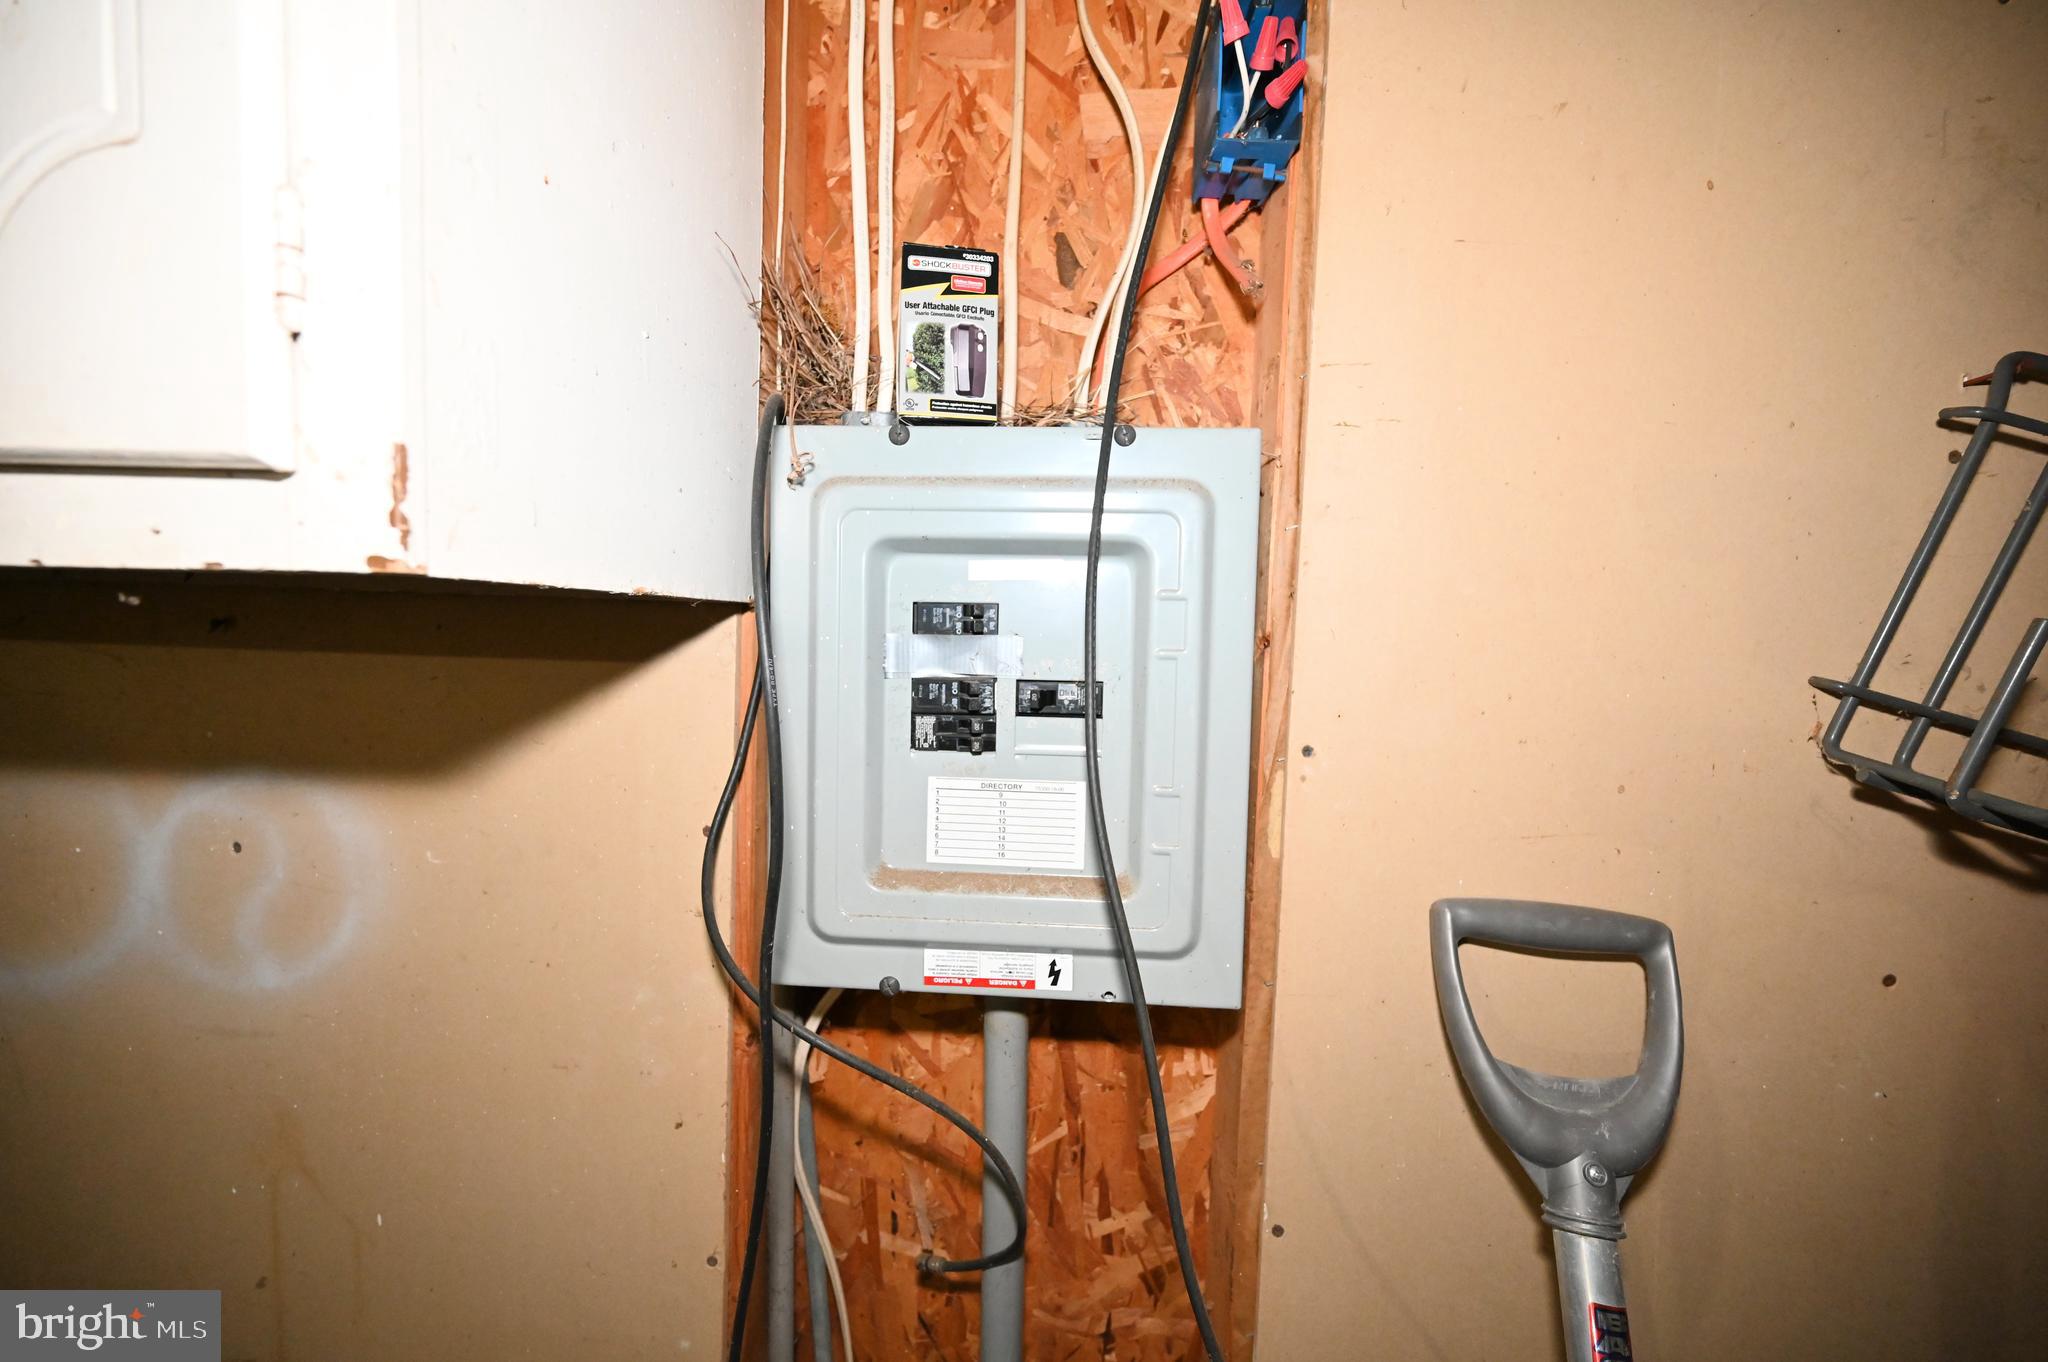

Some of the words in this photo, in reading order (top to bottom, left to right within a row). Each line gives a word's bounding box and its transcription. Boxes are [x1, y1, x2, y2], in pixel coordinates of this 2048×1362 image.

[921, 260, 986, 273] SHOCKBUSTER
[904, 301, 920, 309] User
[922, 301, 960, 312] Attachable
[962, 304, 977, 314] GFCI
[979, 306, 995, 317] Plug
[981, 782, 1022, 790] DIRECTORY
